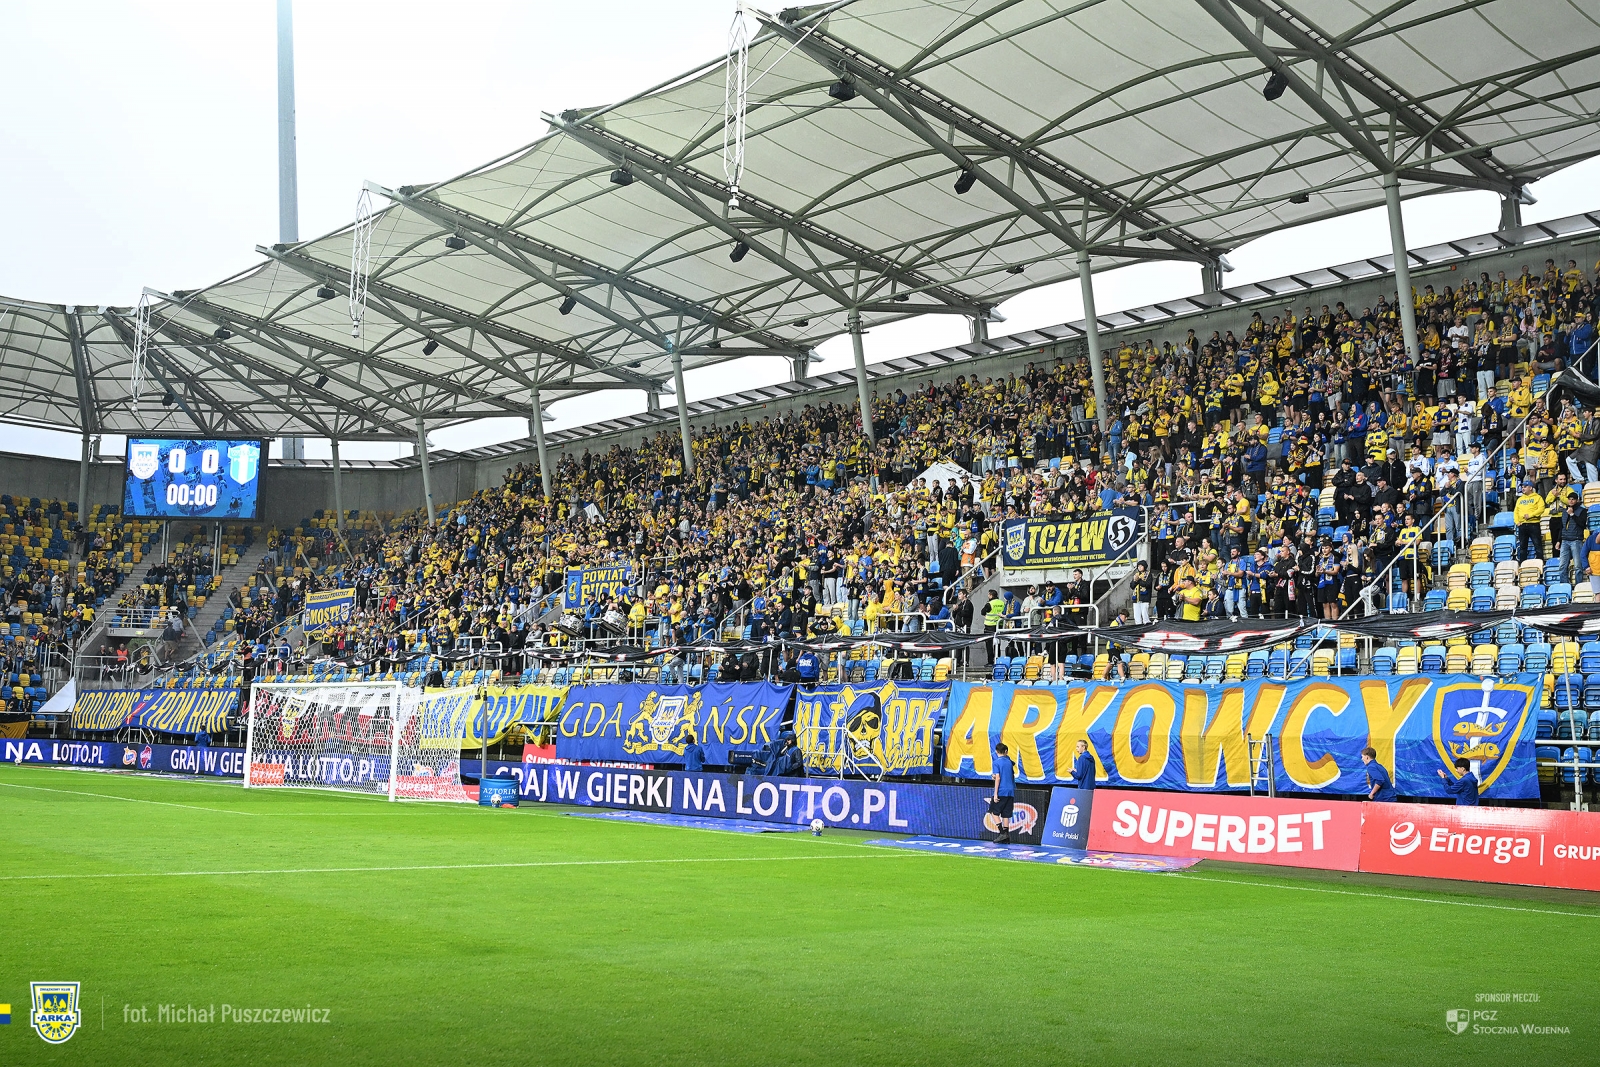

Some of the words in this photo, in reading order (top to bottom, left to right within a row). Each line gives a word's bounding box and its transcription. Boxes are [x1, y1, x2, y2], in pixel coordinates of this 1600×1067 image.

[168, 448, 187, 474] 0
[202, 449, 219, 474] 0
[166, 483, 218, 507] 00:00
[1028, 519, 1109, 555] TCZEW
[582, 568, 625, 584] POWIAT
[310, 604, 341, 626] MOSTY
[71, 691, 141, 730] HOOLIGANS
[139, 691, 193, 733] FROM
[185, 691, 237, 735] ARKA
[560, 702, 623, 739] GDA
[702, 696, 780, 745] ŃSK
[943, 676, 1433, 790] ARKOWCY
[5, 742, 43, 761] NA
[52, 743, 105, 765] LOTTO.PL
[170, 749, 201, 774] GRAJ
[203, 752, 217, 773] W
[482, 787, 517, 795] AZTORIN
[556, 769, 581, 800] W
[586, 772, 676, 810] GIERKI
[682, 774, 726, 814] NA
[736, 777, 909, 828] LOTTO.PL
[1052, 830, 1065, 838] Bank
[1064, 832, 1080, 840] Polski
[1112, 800, 1332, 859] SUPERBET
[1429, 827, 1531, 864] Energa
